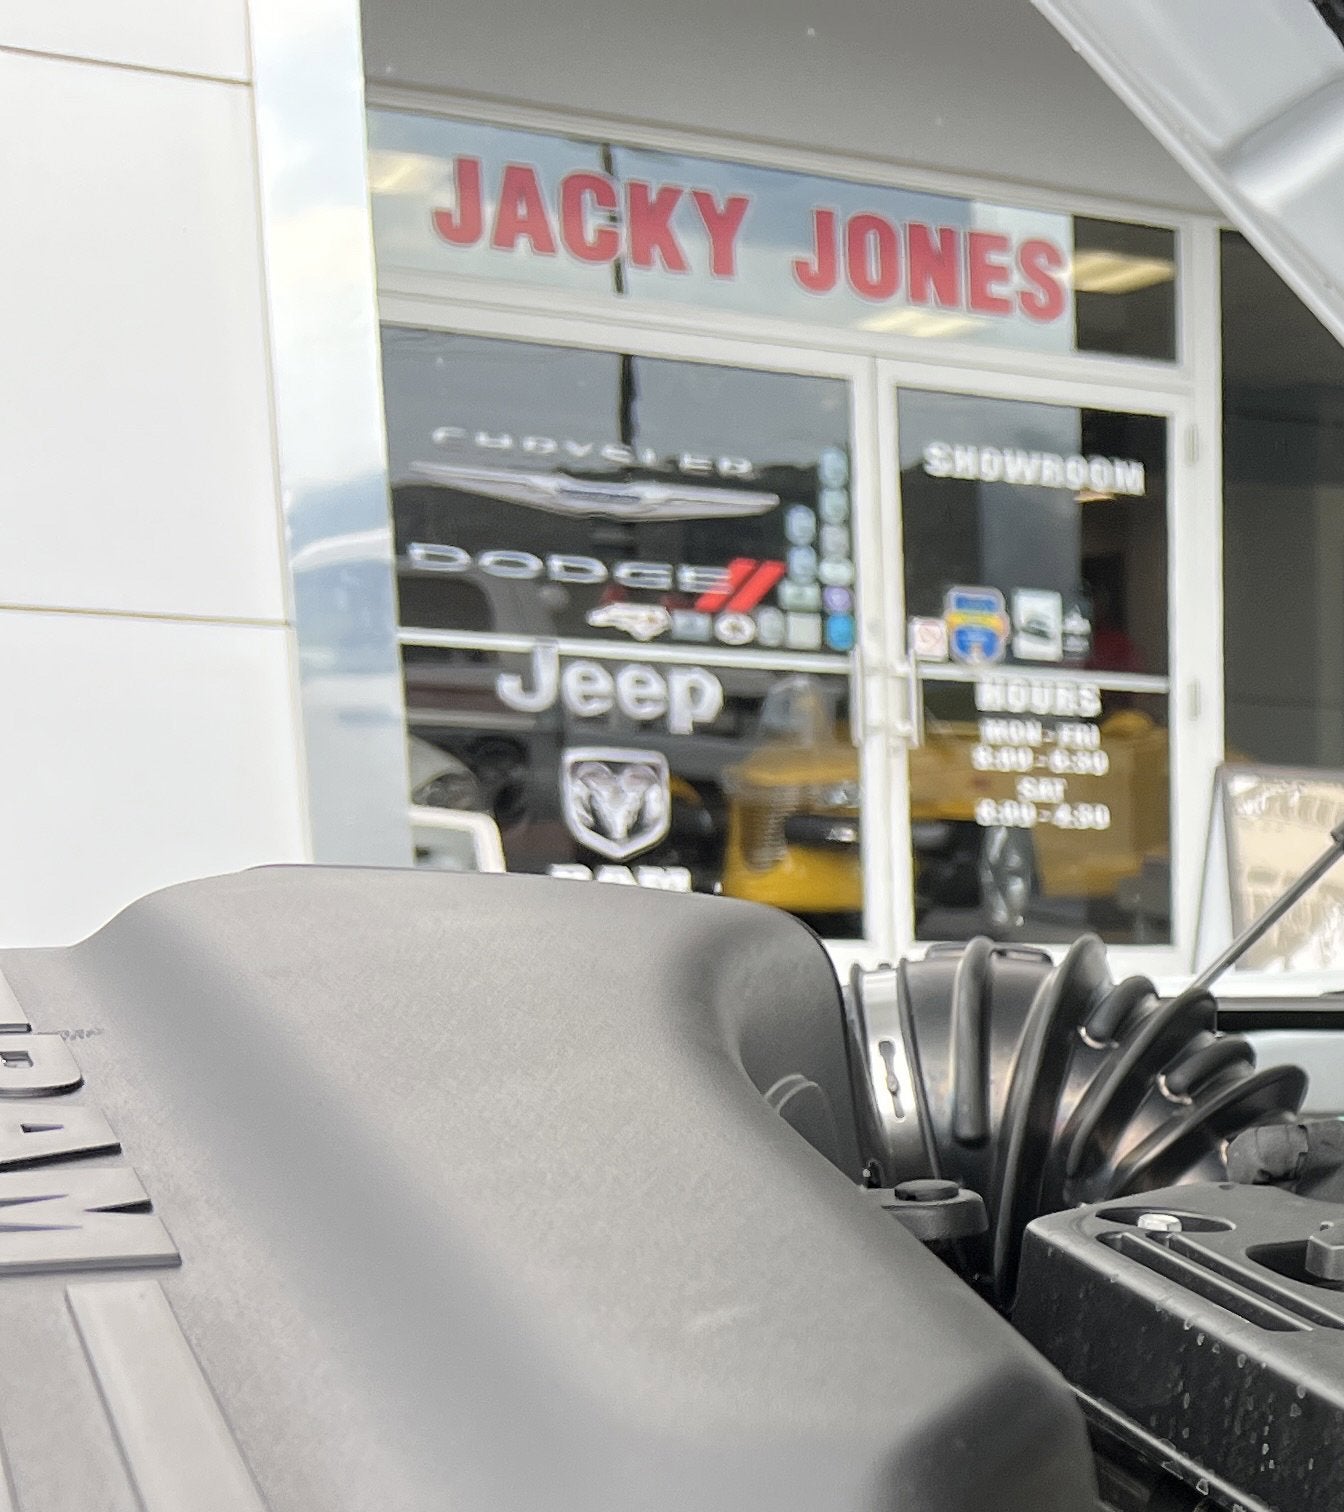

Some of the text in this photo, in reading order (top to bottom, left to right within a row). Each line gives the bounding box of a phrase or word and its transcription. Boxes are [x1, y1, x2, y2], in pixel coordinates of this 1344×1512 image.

[431, 156, 1068, 323] JACKY JONES
[923, 442, 1146, 496] SHOWROOM
[408, 543, 734, 595] DODGE
[497, 636, 724, 735] Jeep
[975, 680, 1102, 717] HOURS
